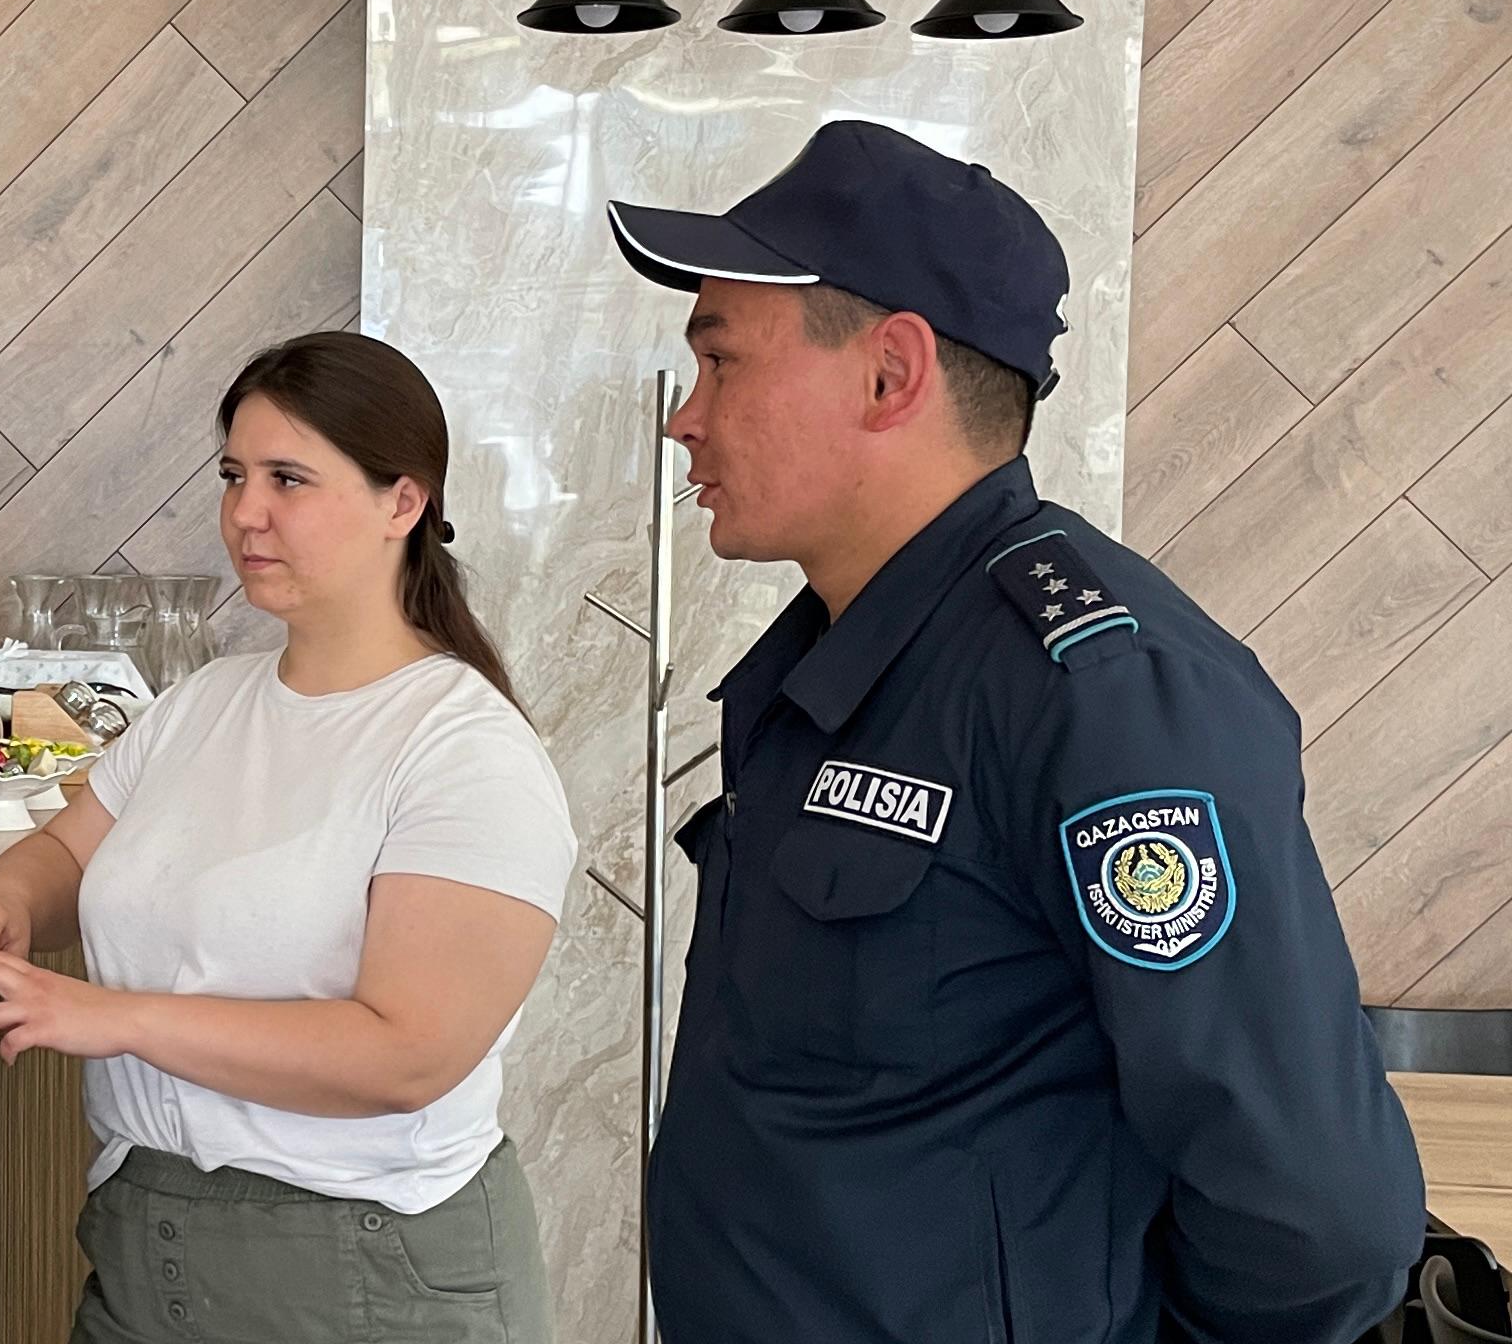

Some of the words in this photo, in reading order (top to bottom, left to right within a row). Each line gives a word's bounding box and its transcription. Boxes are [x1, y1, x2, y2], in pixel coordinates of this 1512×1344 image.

[812, 768, 929, 830] POLISIA
[1076, 807, 1199, 848] QAZAQSTAN
[1088, 883, 1117, 925] ISHKI
[1116, 921, 1162, 940] ISTER
[1165, 857, 1217, 938] MINISTRLIGI
